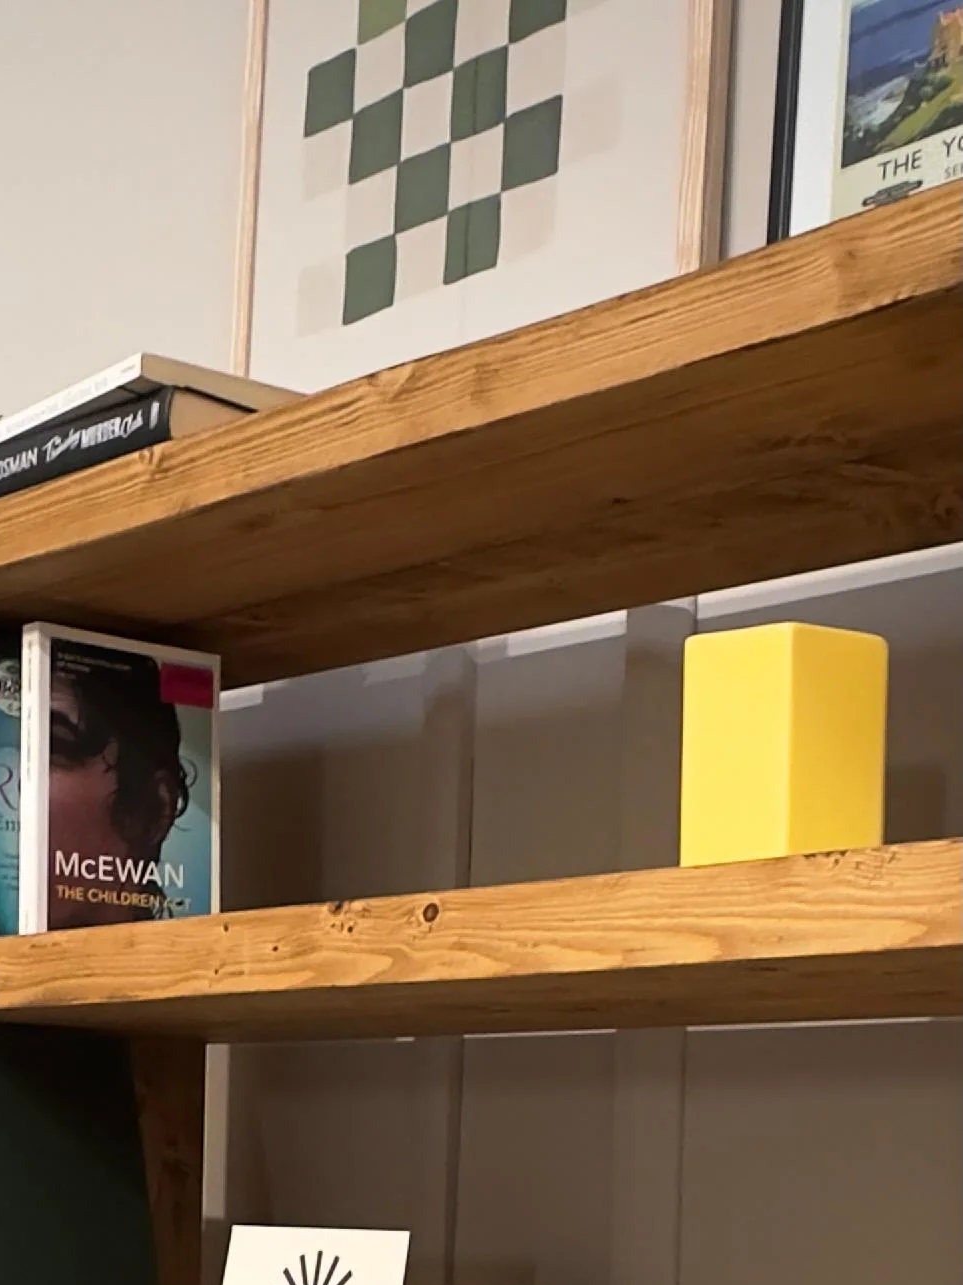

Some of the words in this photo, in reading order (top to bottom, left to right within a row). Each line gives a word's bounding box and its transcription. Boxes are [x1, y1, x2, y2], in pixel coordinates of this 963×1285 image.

[877, 149, 923, 181] THE
[54, 850, 184, 889] McEWAN
[56, 884, 84, 901] THE
[88, 888, 160, 908] CHILDREN
